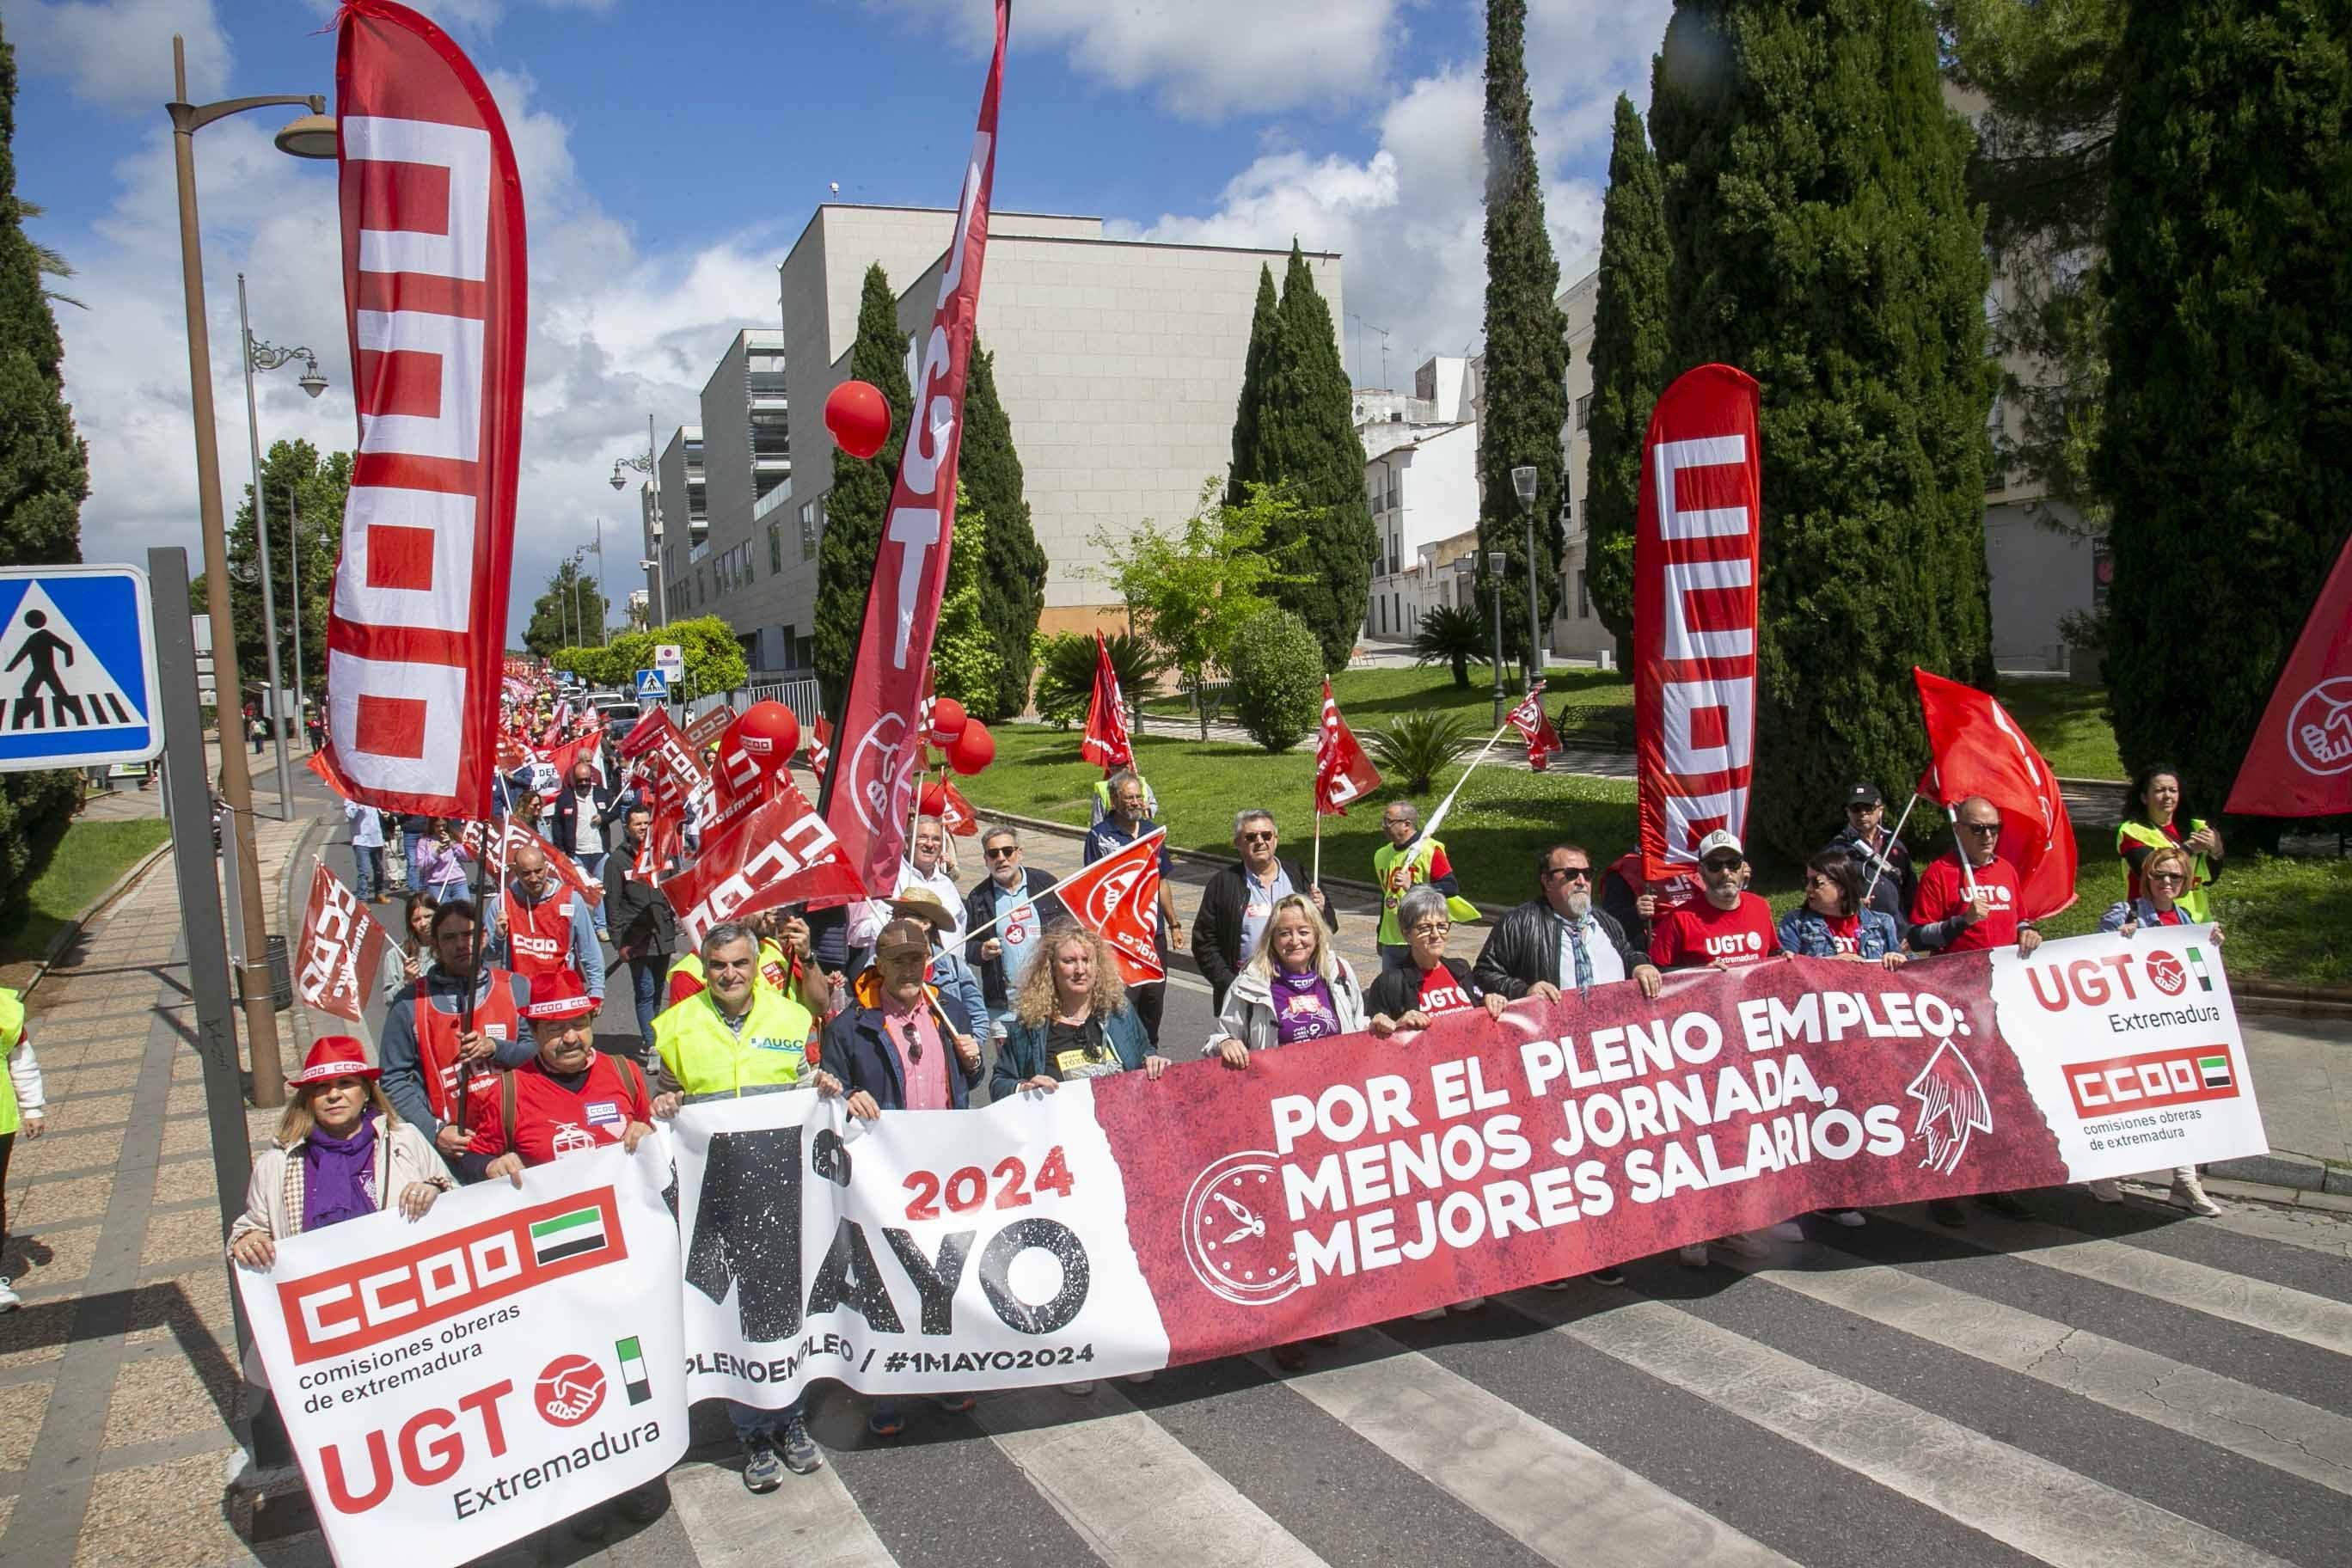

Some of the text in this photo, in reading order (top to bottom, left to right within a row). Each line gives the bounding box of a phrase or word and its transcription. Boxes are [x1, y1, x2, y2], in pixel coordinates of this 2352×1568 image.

[512, 933, 558, 952] CCOO
[1706, 934, 1745, 956] UGT
[2025, 953, 2138, 1013] UGT
[763, 1038, 804, 1049] AUGC
[2108, 1004, 2220, 1033] Extremadura
[1271, 989, 1973, 1156] POR EL PLENO EMPLEO:
[2073, 1059, 2200, 1108] CCOO
[1281, 1056, 1838, 1222] MENOS JORNADA,
[2084, 1107, 2202, 1136] comisiones obreras
[2090, 1125, 2185, 1151] de extremadura
[902, 1144, 1075, 1221] 2024
[1291, 1103, 1907, 1288] MEJORES SALARIOS
[298, 1229, 523, 1344] CCOO
[298, 1304, 521, 1391] comisiones obreras
[303, 1338, 483, 1414] de extremadura
[884, 1342, 1094, 1374] #1MAYO2024
[319, 1378, 514, 1516] UGT
[452, 1418, 661, 1521] Extremadura
